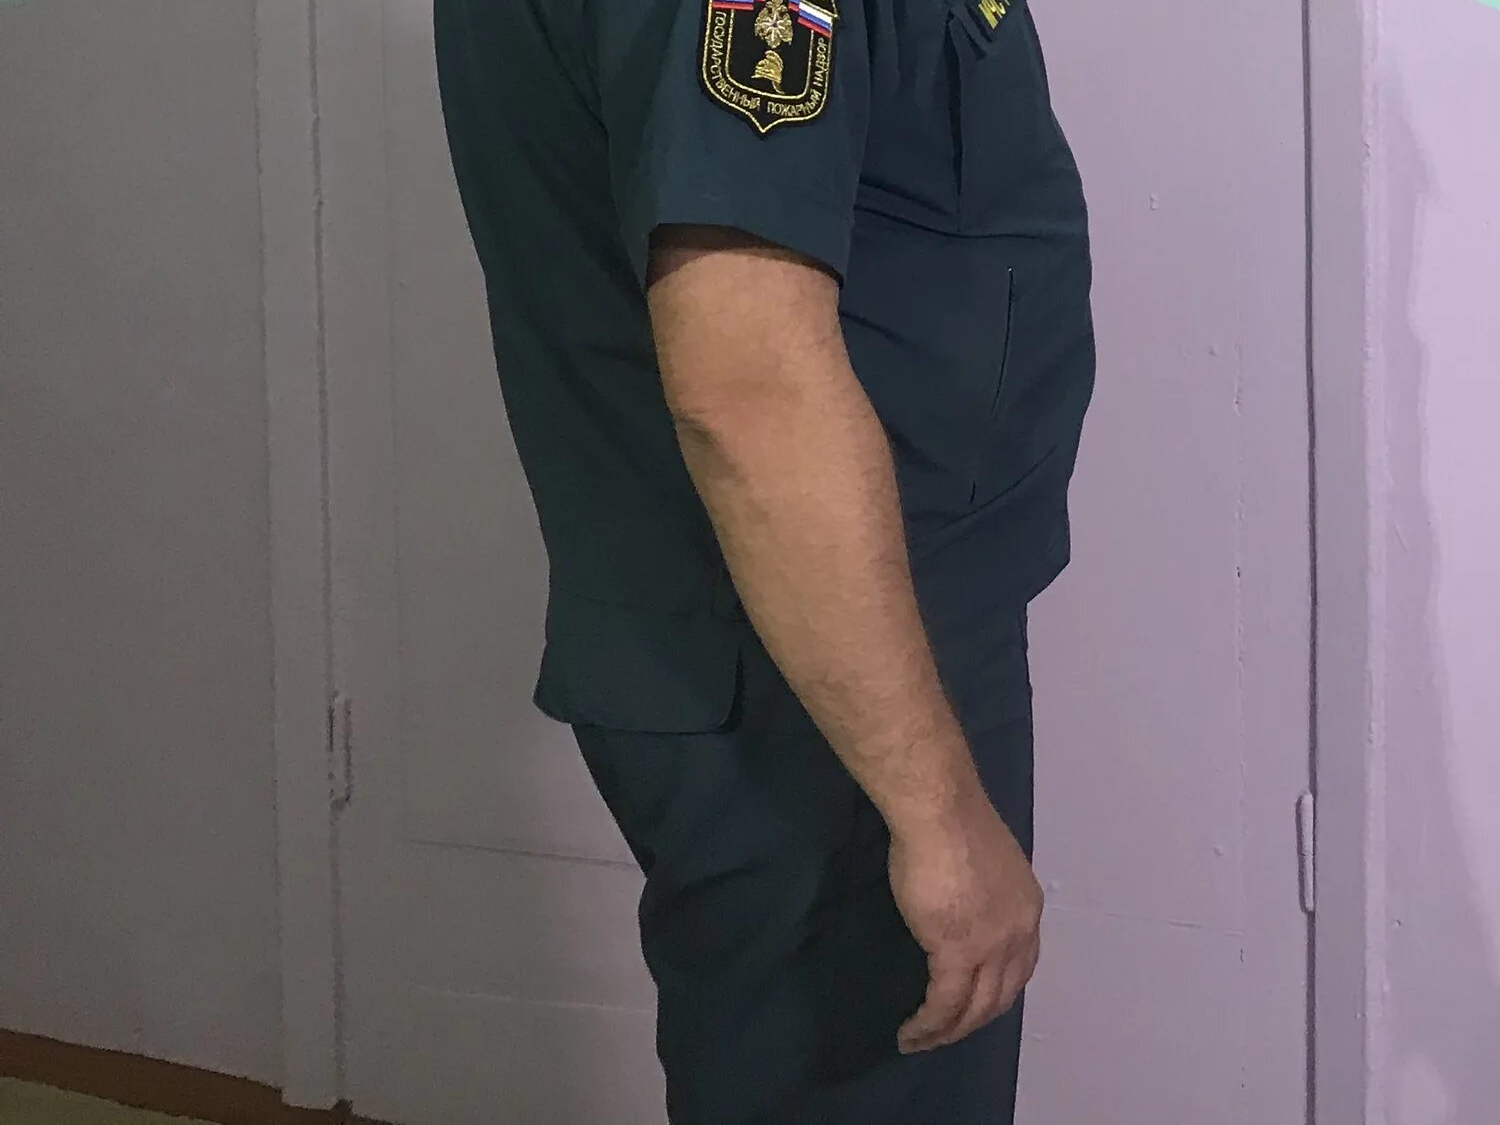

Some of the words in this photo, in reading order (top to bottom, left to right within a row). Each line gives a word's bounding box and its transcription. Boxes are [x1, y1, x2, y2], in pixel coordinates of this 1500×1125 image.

[710, 11, 761, 112] ГОСУДАРСТВЕННЫЙ
[767, 89, 822, 117] ПОЖАРНЫЙ
[812, 37, 828, 87] НАДЗОР
